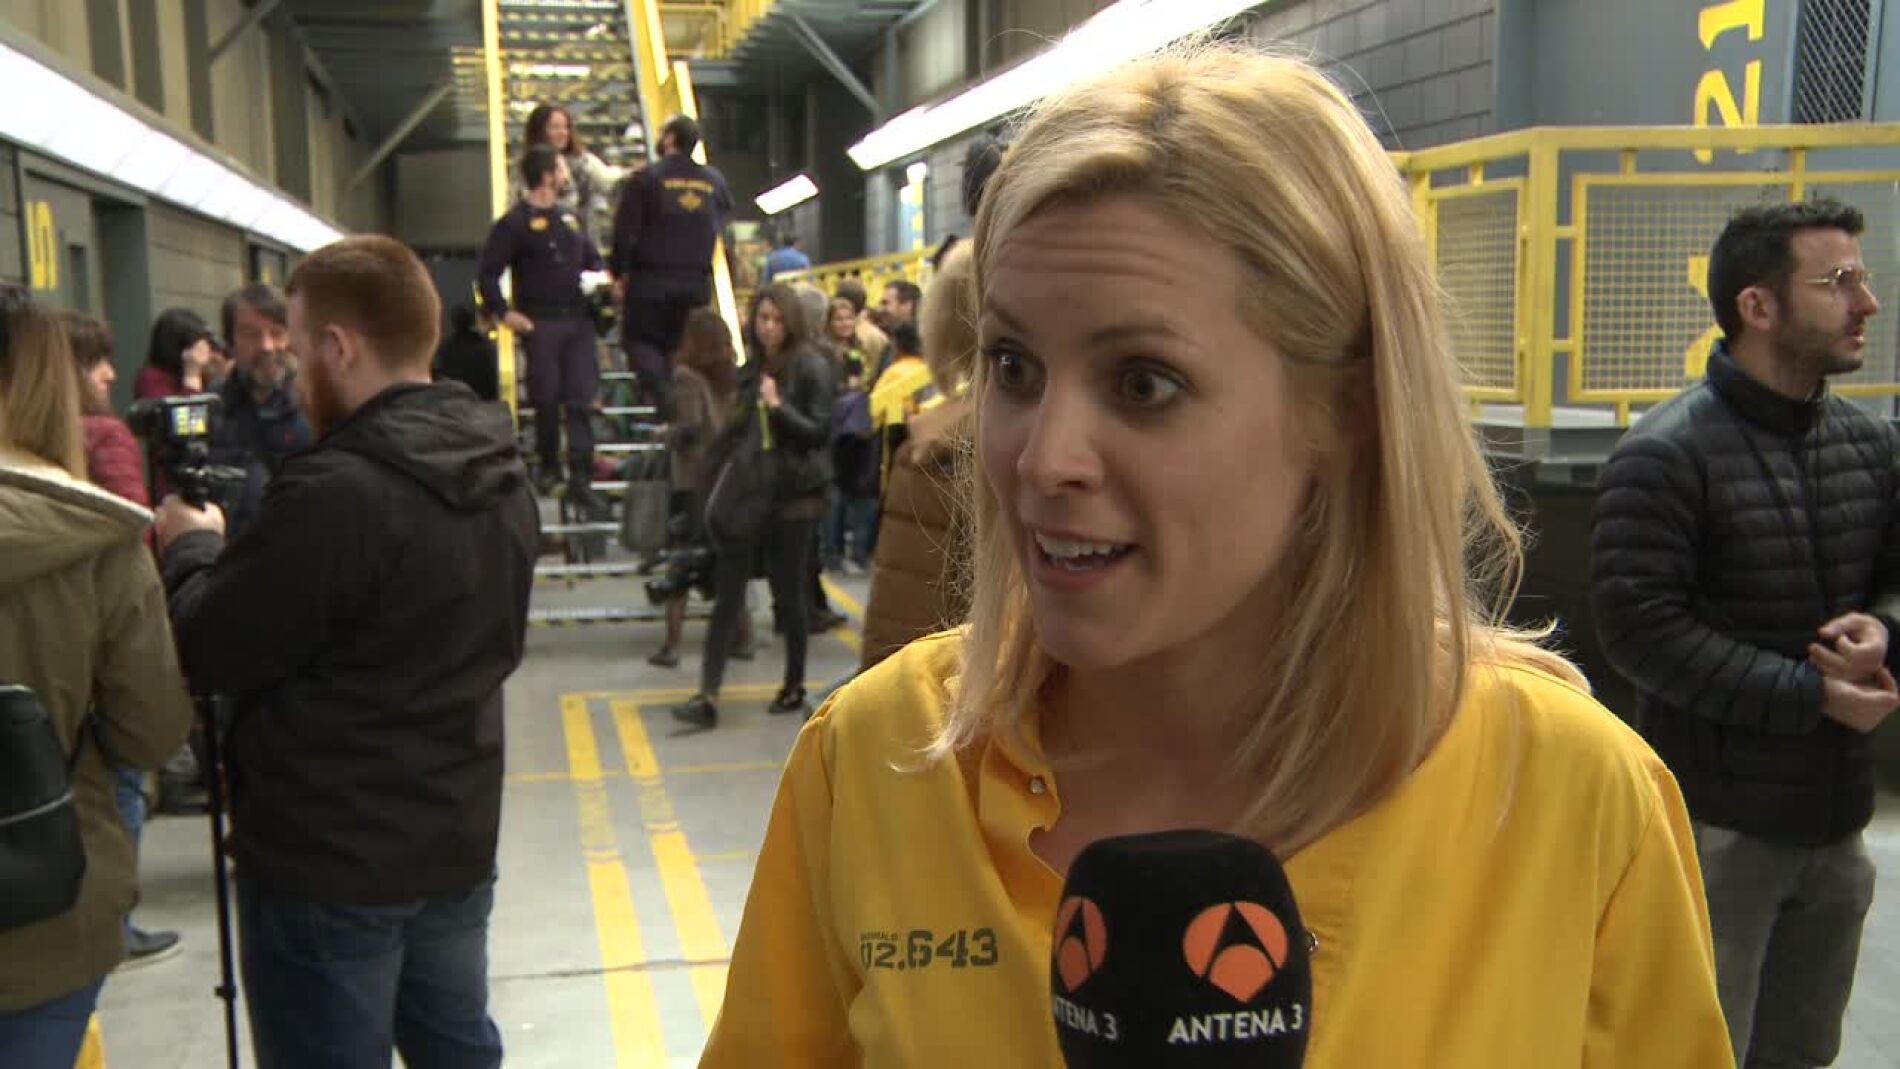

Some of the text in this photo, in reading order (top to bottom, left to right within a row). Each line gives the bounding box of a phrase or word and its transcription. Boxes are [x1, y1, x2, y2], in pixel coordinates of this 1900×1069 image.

[1103, 1012, 1118, 1040] 3
[1167, 1003, 1303, 1044] ANTENA 3
